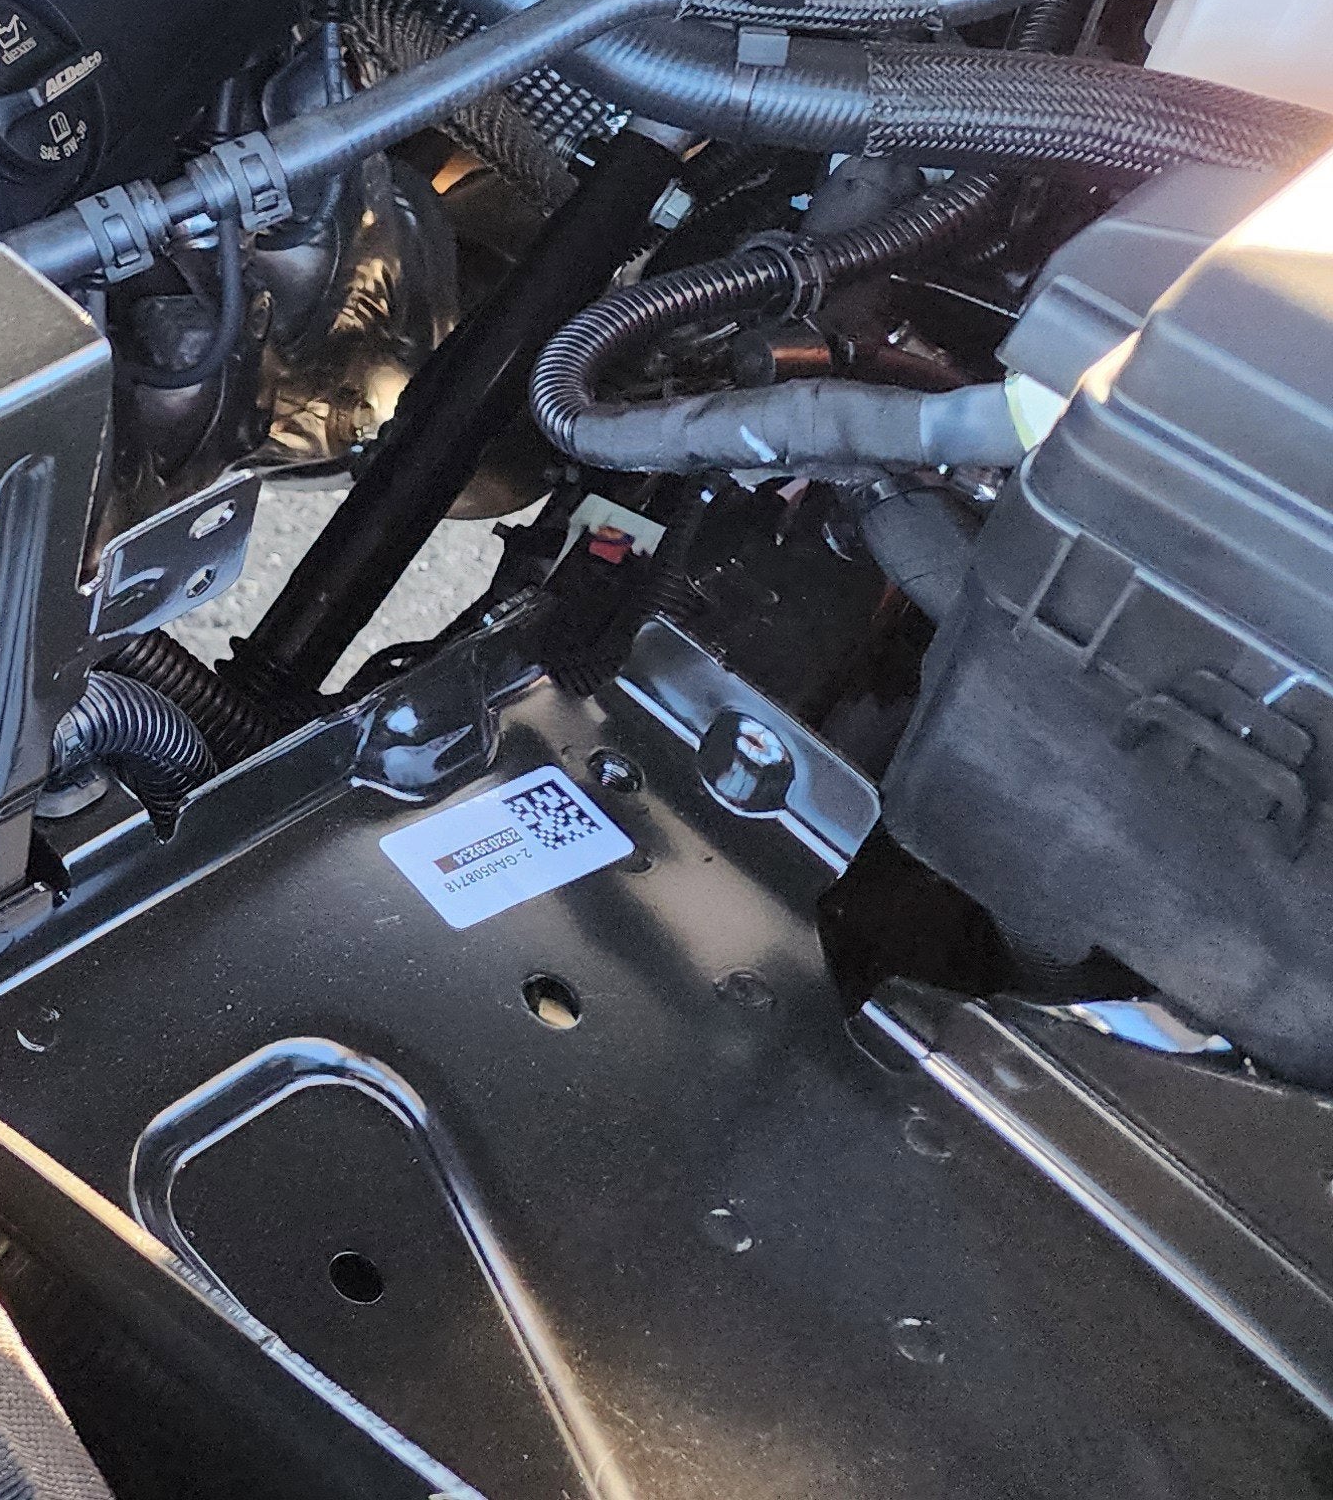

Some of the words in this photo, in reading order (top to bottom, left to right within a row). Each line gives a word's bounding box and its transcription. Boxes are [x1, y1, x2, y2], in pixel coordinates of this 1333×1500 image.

[46, 51, 102, 98] ACDelco
[40, 144, 61, 161] SAE
[452, 828, 521, 866] 262039234
